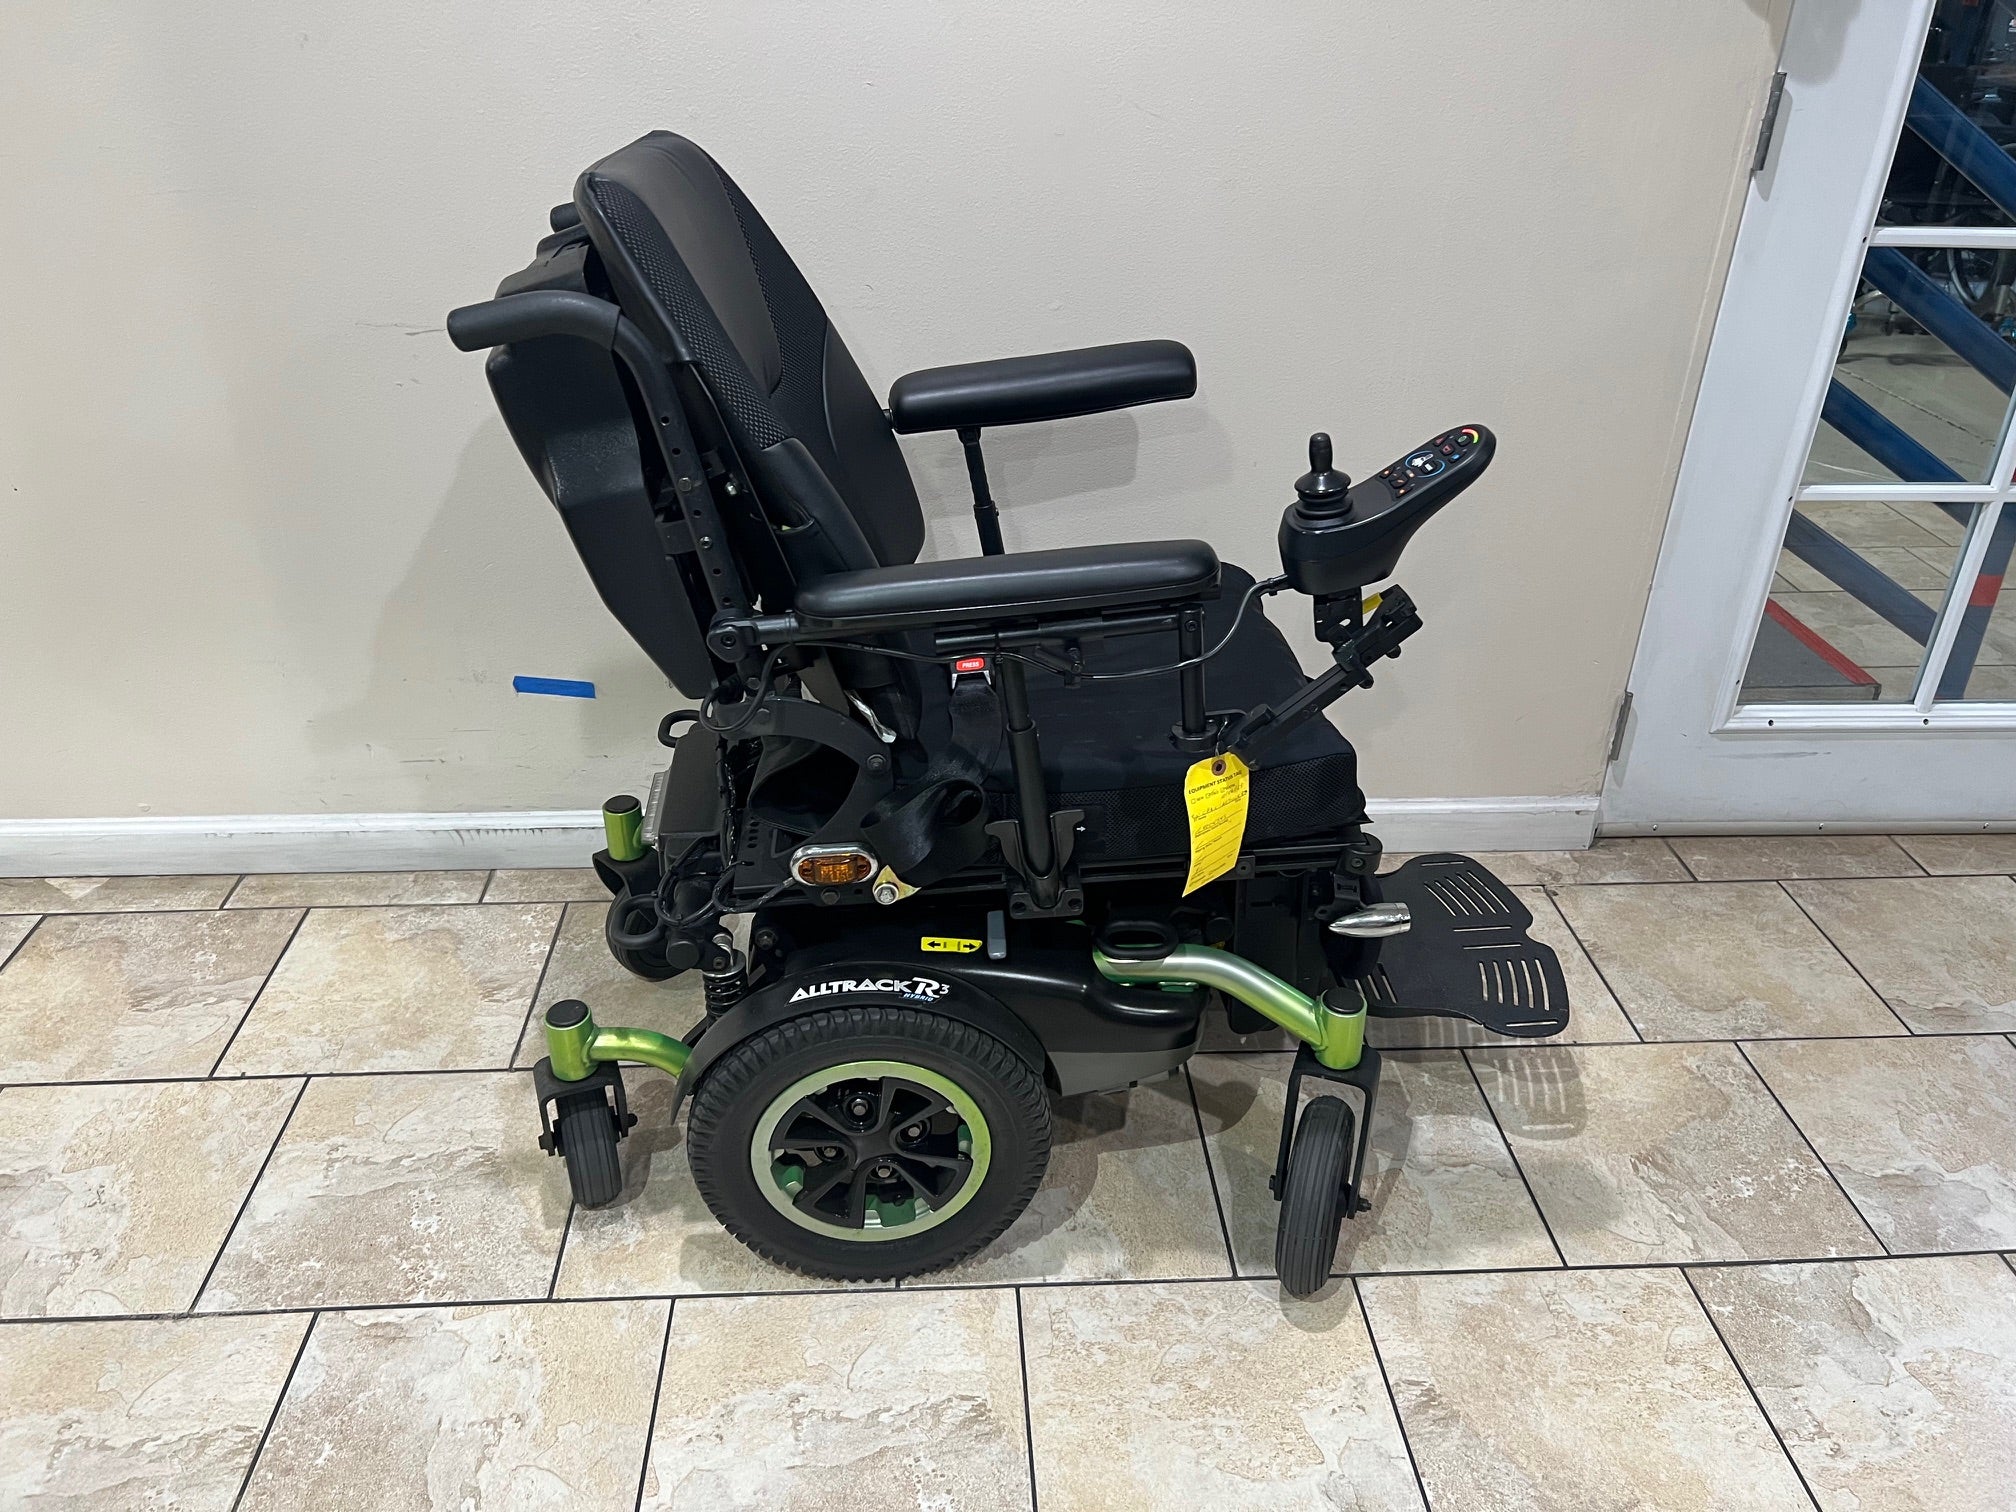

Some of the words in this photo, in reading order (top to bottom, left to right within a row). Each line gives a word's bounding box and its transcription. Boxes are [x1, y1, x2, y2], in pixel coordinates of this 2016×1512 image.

[960, 661, 980, 669] PRESS
[1188, 781, 1217, 795] EQUIPMENT
[1216, 774, 1233, 785] STATUS
[788, 978, 913, 1003] ALLTRACK
[903, 993, 934, 1002] HYBRID
